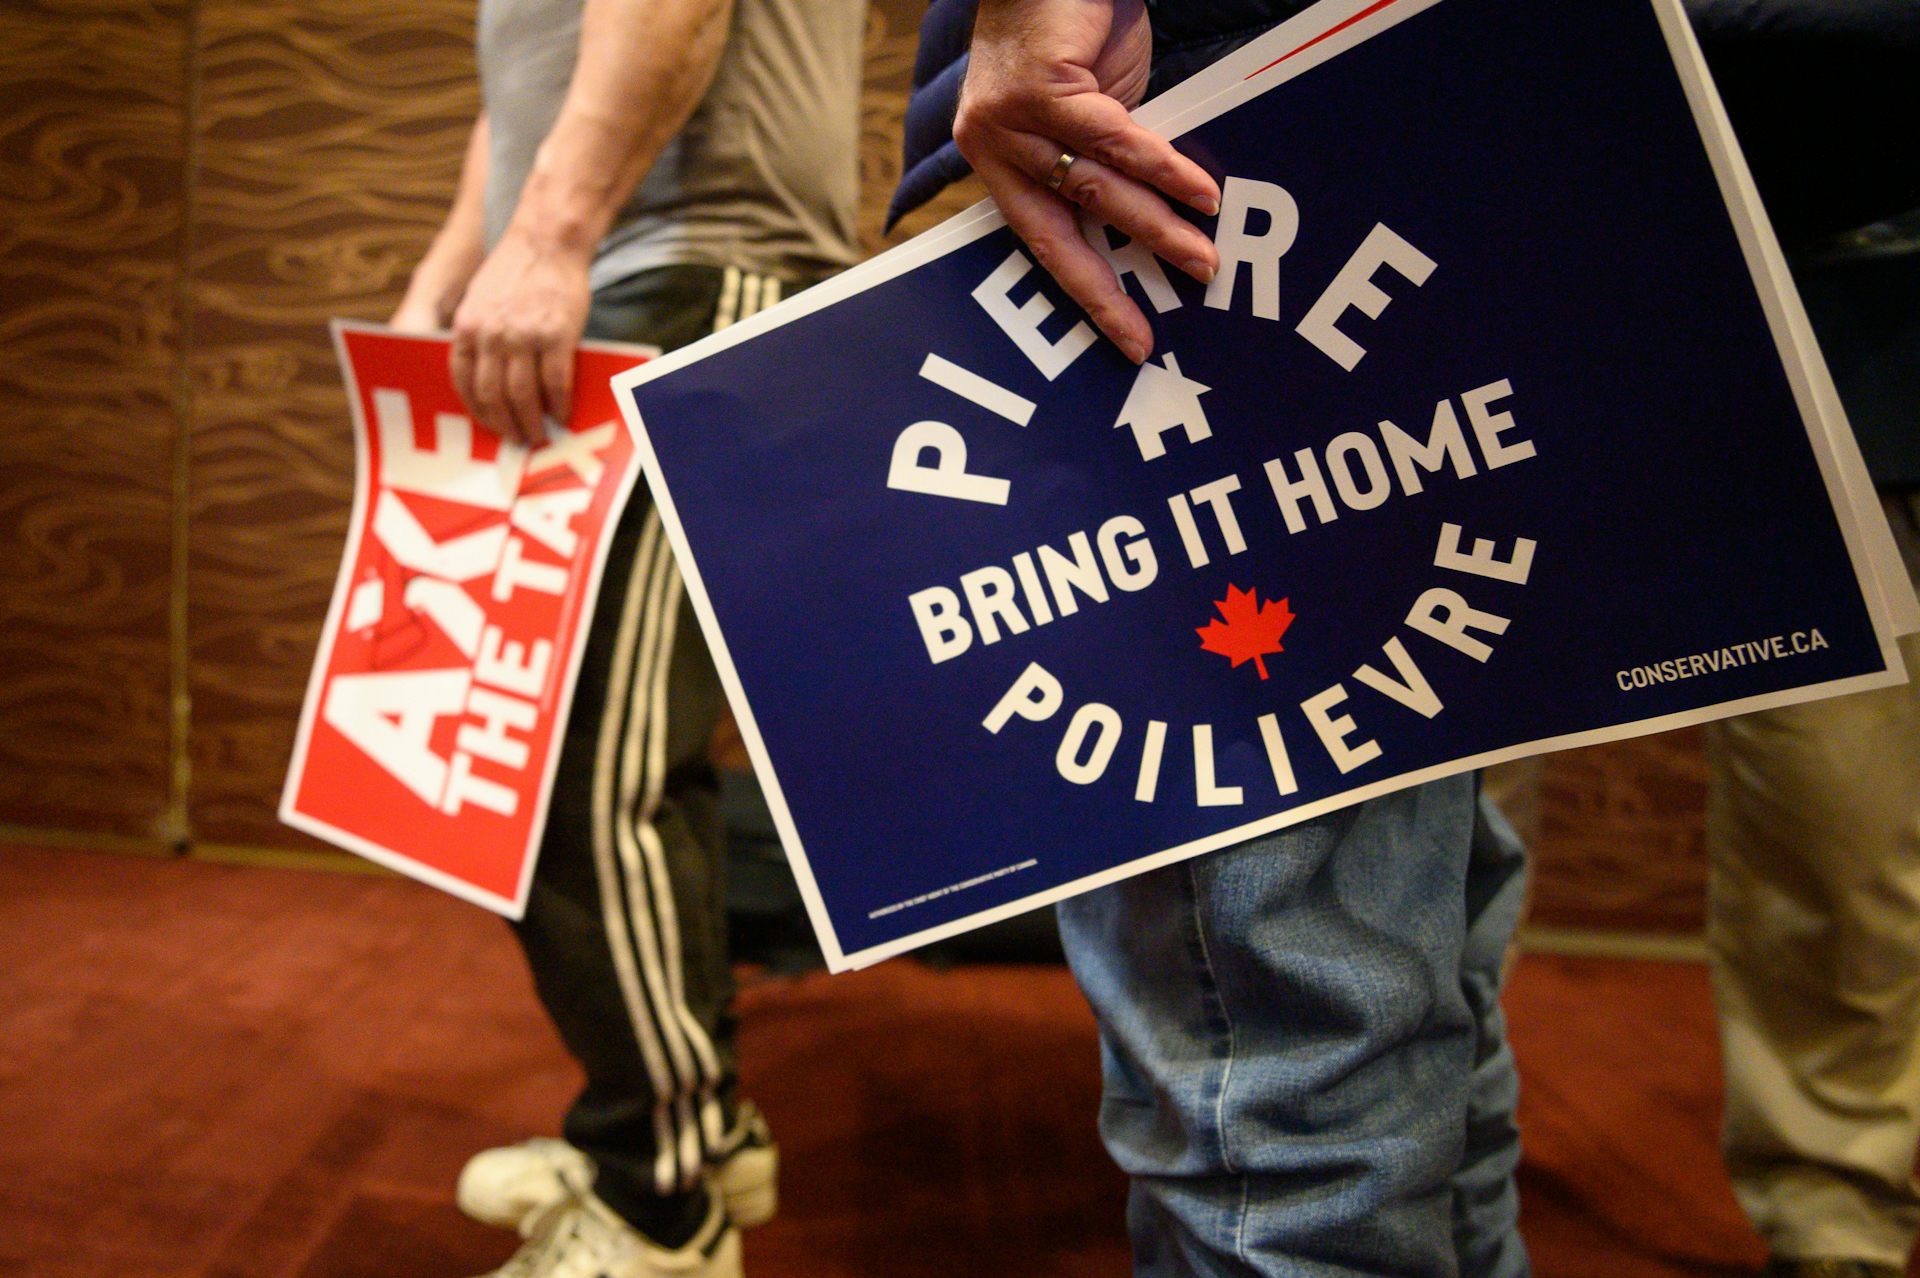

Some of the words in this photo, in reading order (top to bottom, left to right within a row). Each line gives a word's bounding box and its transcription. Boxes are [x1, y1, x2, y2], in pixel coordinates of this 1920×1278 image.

[323, 387, 534, 809] AXE
[491, 417, 618, 602] TAX
[907, 514, 1159, 665] BRING
[1167, 473, 1248, 569] IT
[1262, 378, 1537, 535] HOME
[440, 626, 552, 817] THE
[981, 522, 1537, 808] POILIEVRE
[1616, 628, 1830, 691] CONSERVATIVE.CA
